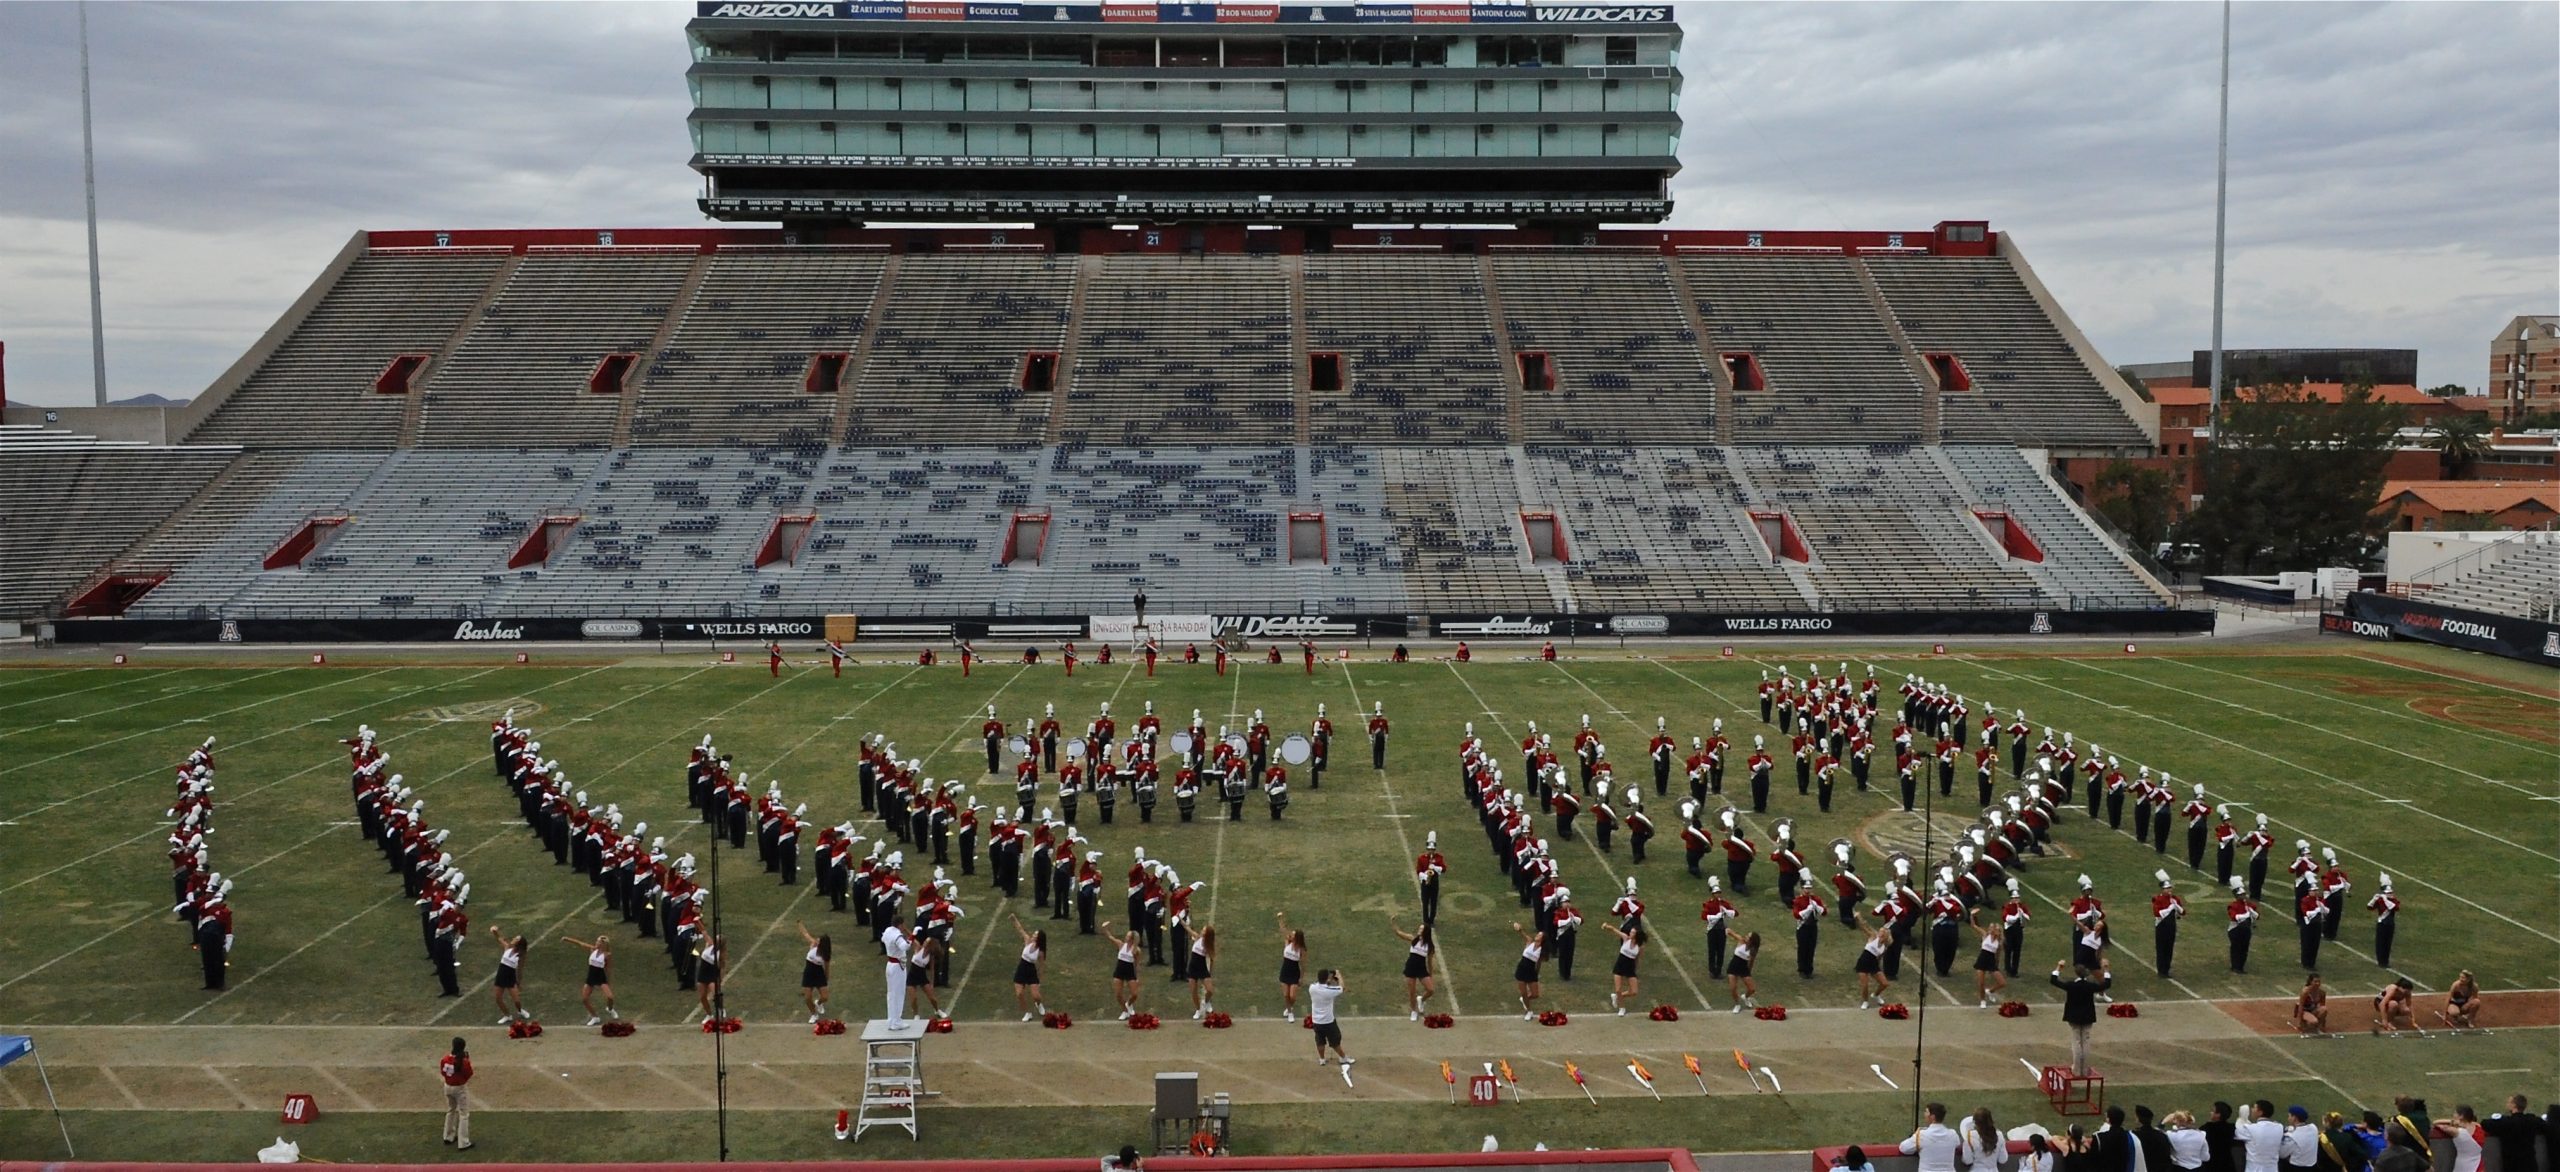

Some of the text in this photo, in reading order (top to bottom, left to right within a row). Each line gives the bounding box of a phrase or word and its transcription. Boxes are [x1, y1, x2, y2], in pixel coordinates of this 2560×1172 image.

[712, 4, 835, 18] ARIZONA
[851, 6, 903, 15] 22 ART LUPPINO
[938, 7, 964, 15] HUNLEY
[1239, 9, 1272, 17] WALDROP
[1536, 8, 1666, 21] WILDCATS
[438, 238, 448, 246] 17
[600, 237, 612, 246] 18
[1147, 235, 1159, 245] 21
[1379, 236, 1392, 245] 22
[1749, 238, 1761, 247] 24
[1889, 239, 1902, 247] 25
[47, 412, 57, 422] 16
[700, 623, 812, 634] WELLS FARGO
[1093, 622, 1130, 633] UNIVERSITY
[1174, 622, 1193, 632] BAND
[1194, 622, 1207, 632] DAY
[1725, 618, 1832, 630] WELLS FARGO
[454, 621, 524, 640] Bashas'
[1474, 1080, 1492, 1100] 40
[284, 1098, 304, 1120] 40
